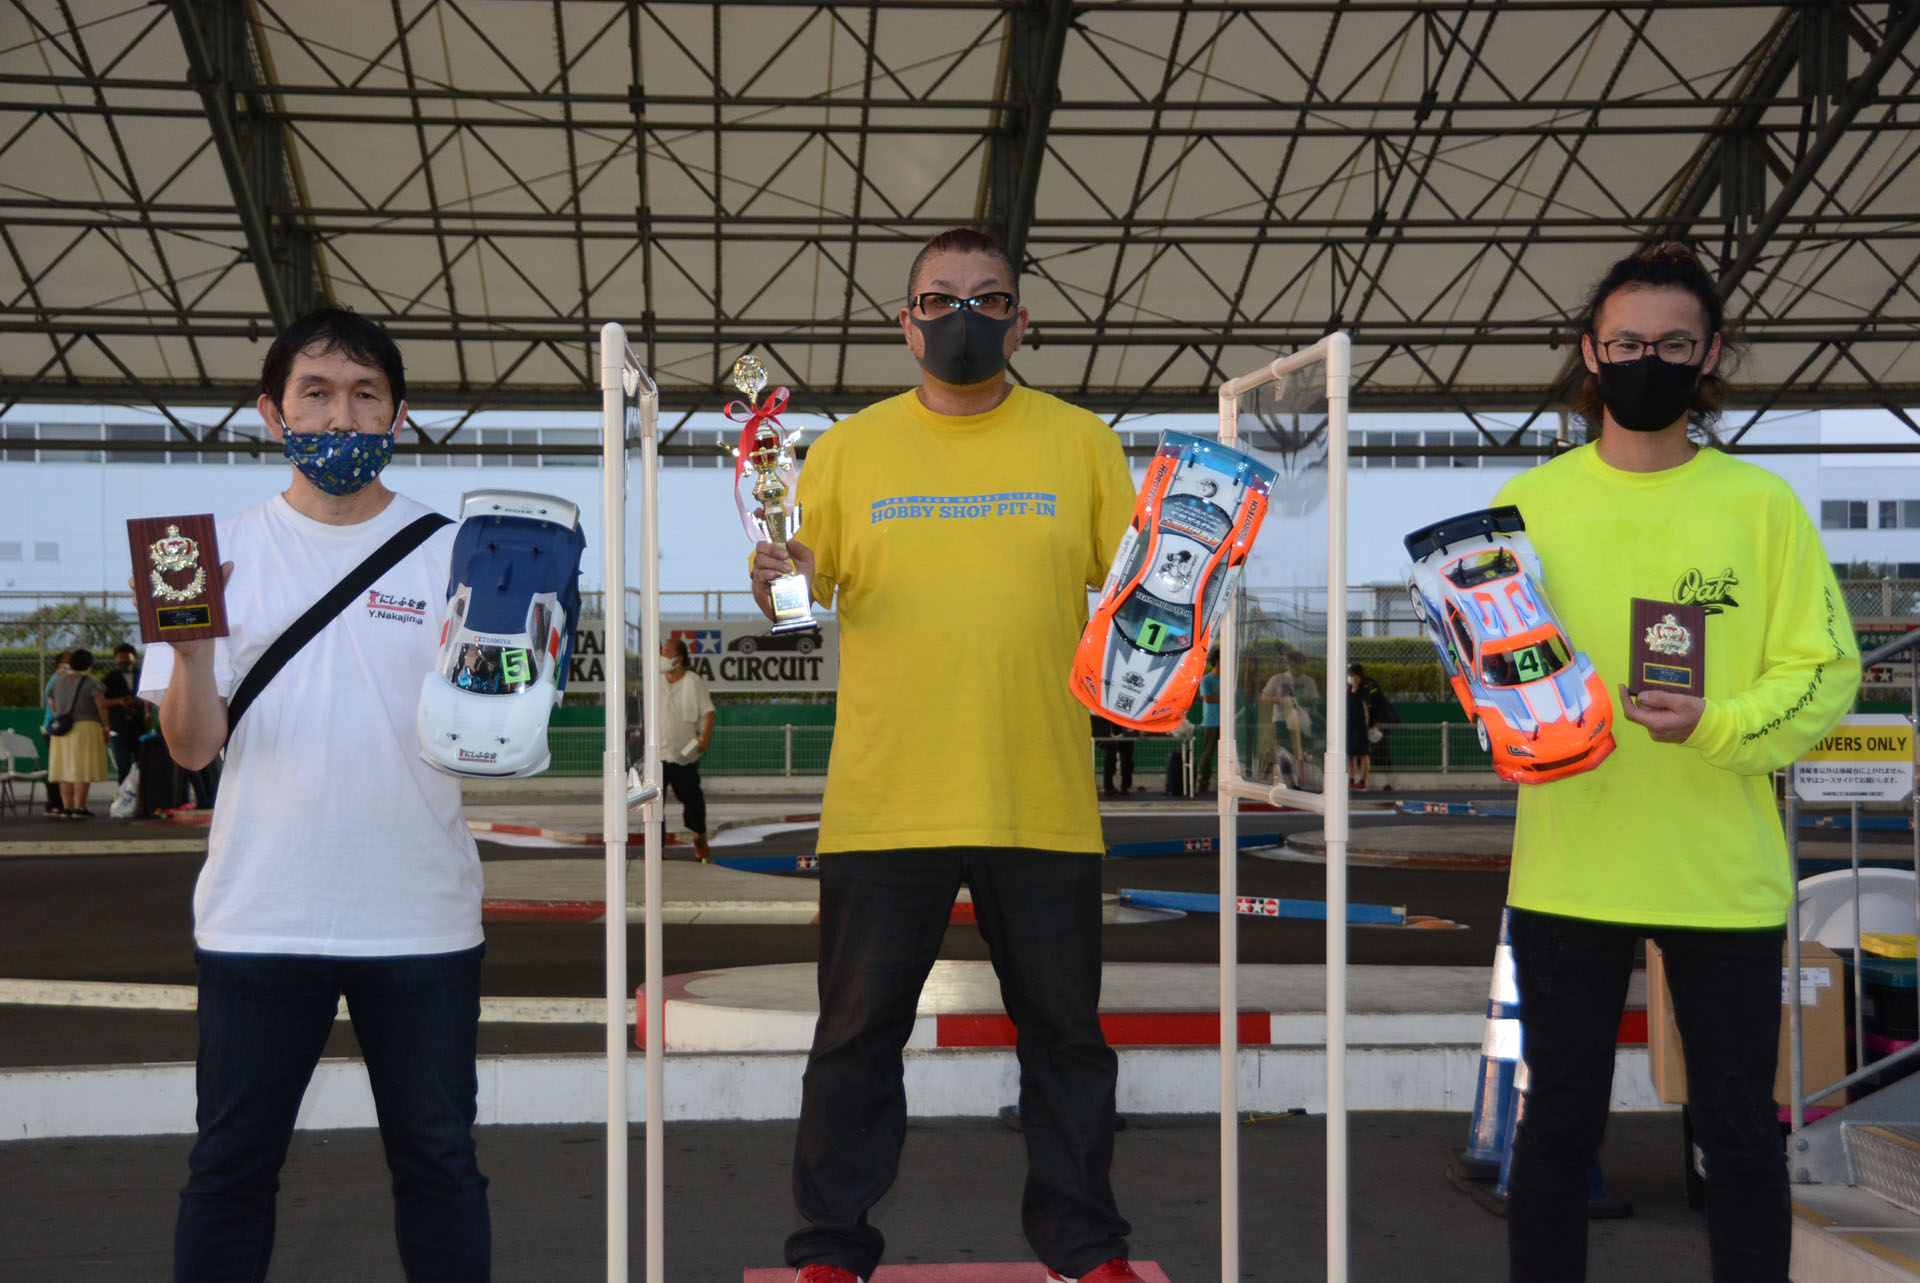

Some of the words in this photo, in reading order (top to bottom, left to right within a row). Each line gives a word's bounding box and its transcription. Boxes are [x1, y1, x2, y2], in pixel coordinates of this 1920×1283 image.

[872, 505, 935, 524] HOBBY
[939, 505, 993, 518] SHOP
[997, 502, 1056, 517] PIT-IN
[369, 610, 423, 625] Y.Nakajima
[488, 636, 512, 645] TAMIYA
[1147, 623, 1162, 646] 1
[505, 652, 526, 678] 5
[719, 656, 824, 681] CIRCUIT
[1519, 649, 1539, 672] 4
[1867, 736, 1908, 752] ONLY
